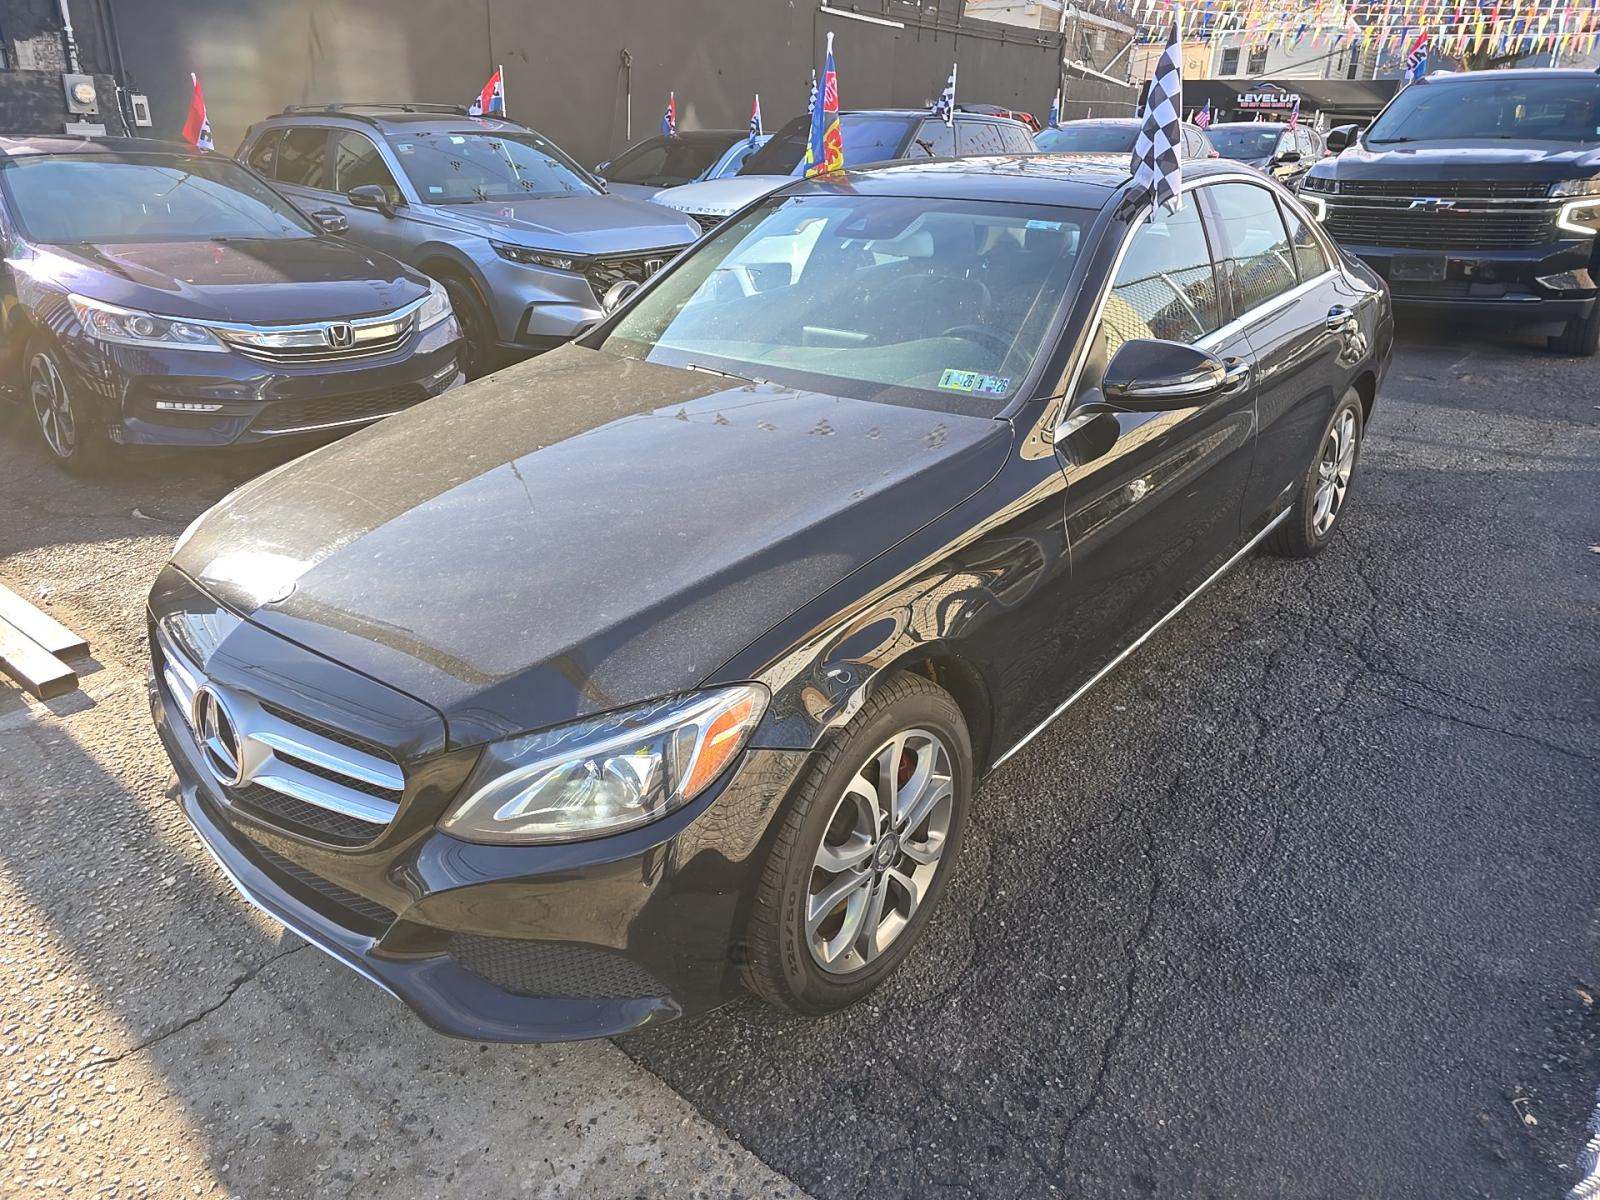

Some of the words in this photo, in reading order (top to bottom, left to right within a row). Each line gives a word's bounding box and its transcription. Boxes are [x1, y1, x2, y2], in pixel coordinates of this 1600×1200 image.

[1237, 93, 1278, 102] LEVEL
[1279, 93, 1299, 102] UP
[785, 891, 800, 976] 225/50
